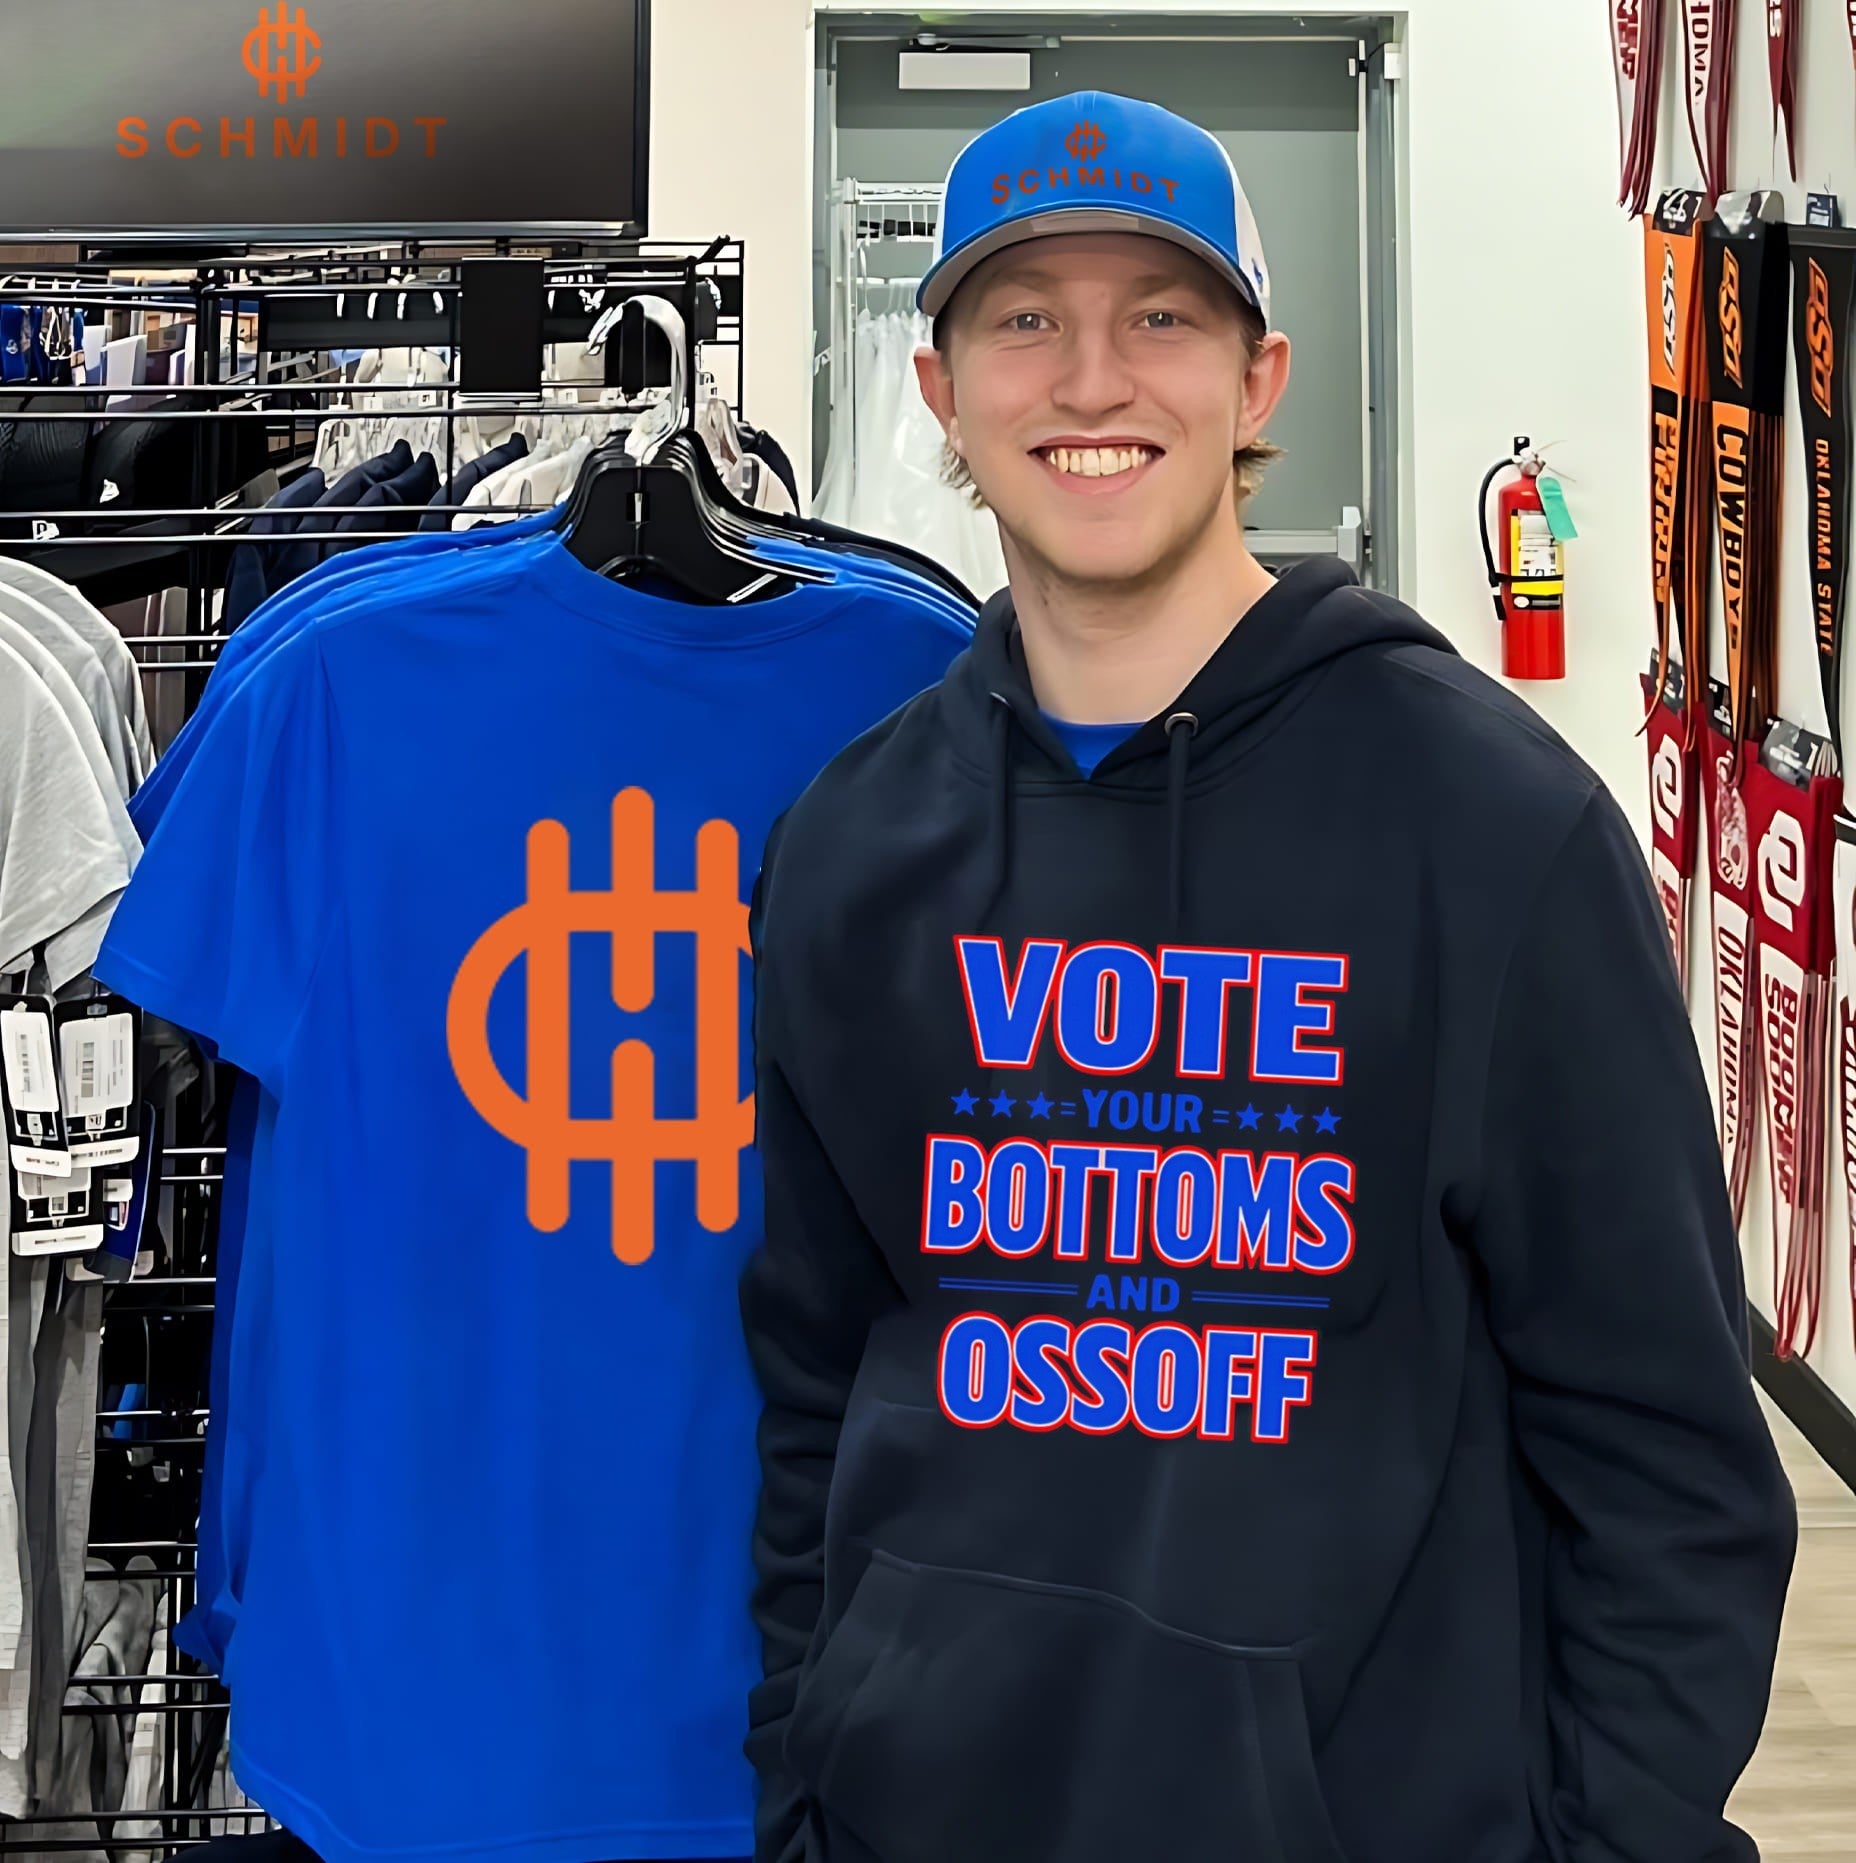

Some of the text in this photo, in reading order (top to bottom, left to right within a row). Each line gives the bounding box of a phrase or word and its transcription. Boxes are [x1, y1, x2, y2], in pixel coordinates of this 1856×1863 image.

[115, 116, 447, 158] SCHMIDT
[991, 167, 1178, 204] SCHMIDT
[952, 934, 1350, 1086] VOTE
[1081, 1087, 1203, 1134] YOUR
[920, 1133, 1356, 1275] BOTTOMS
[1085, 1273, 1181, 1313] AND
[937, 1310, 1318, 1444] OSSOFF
